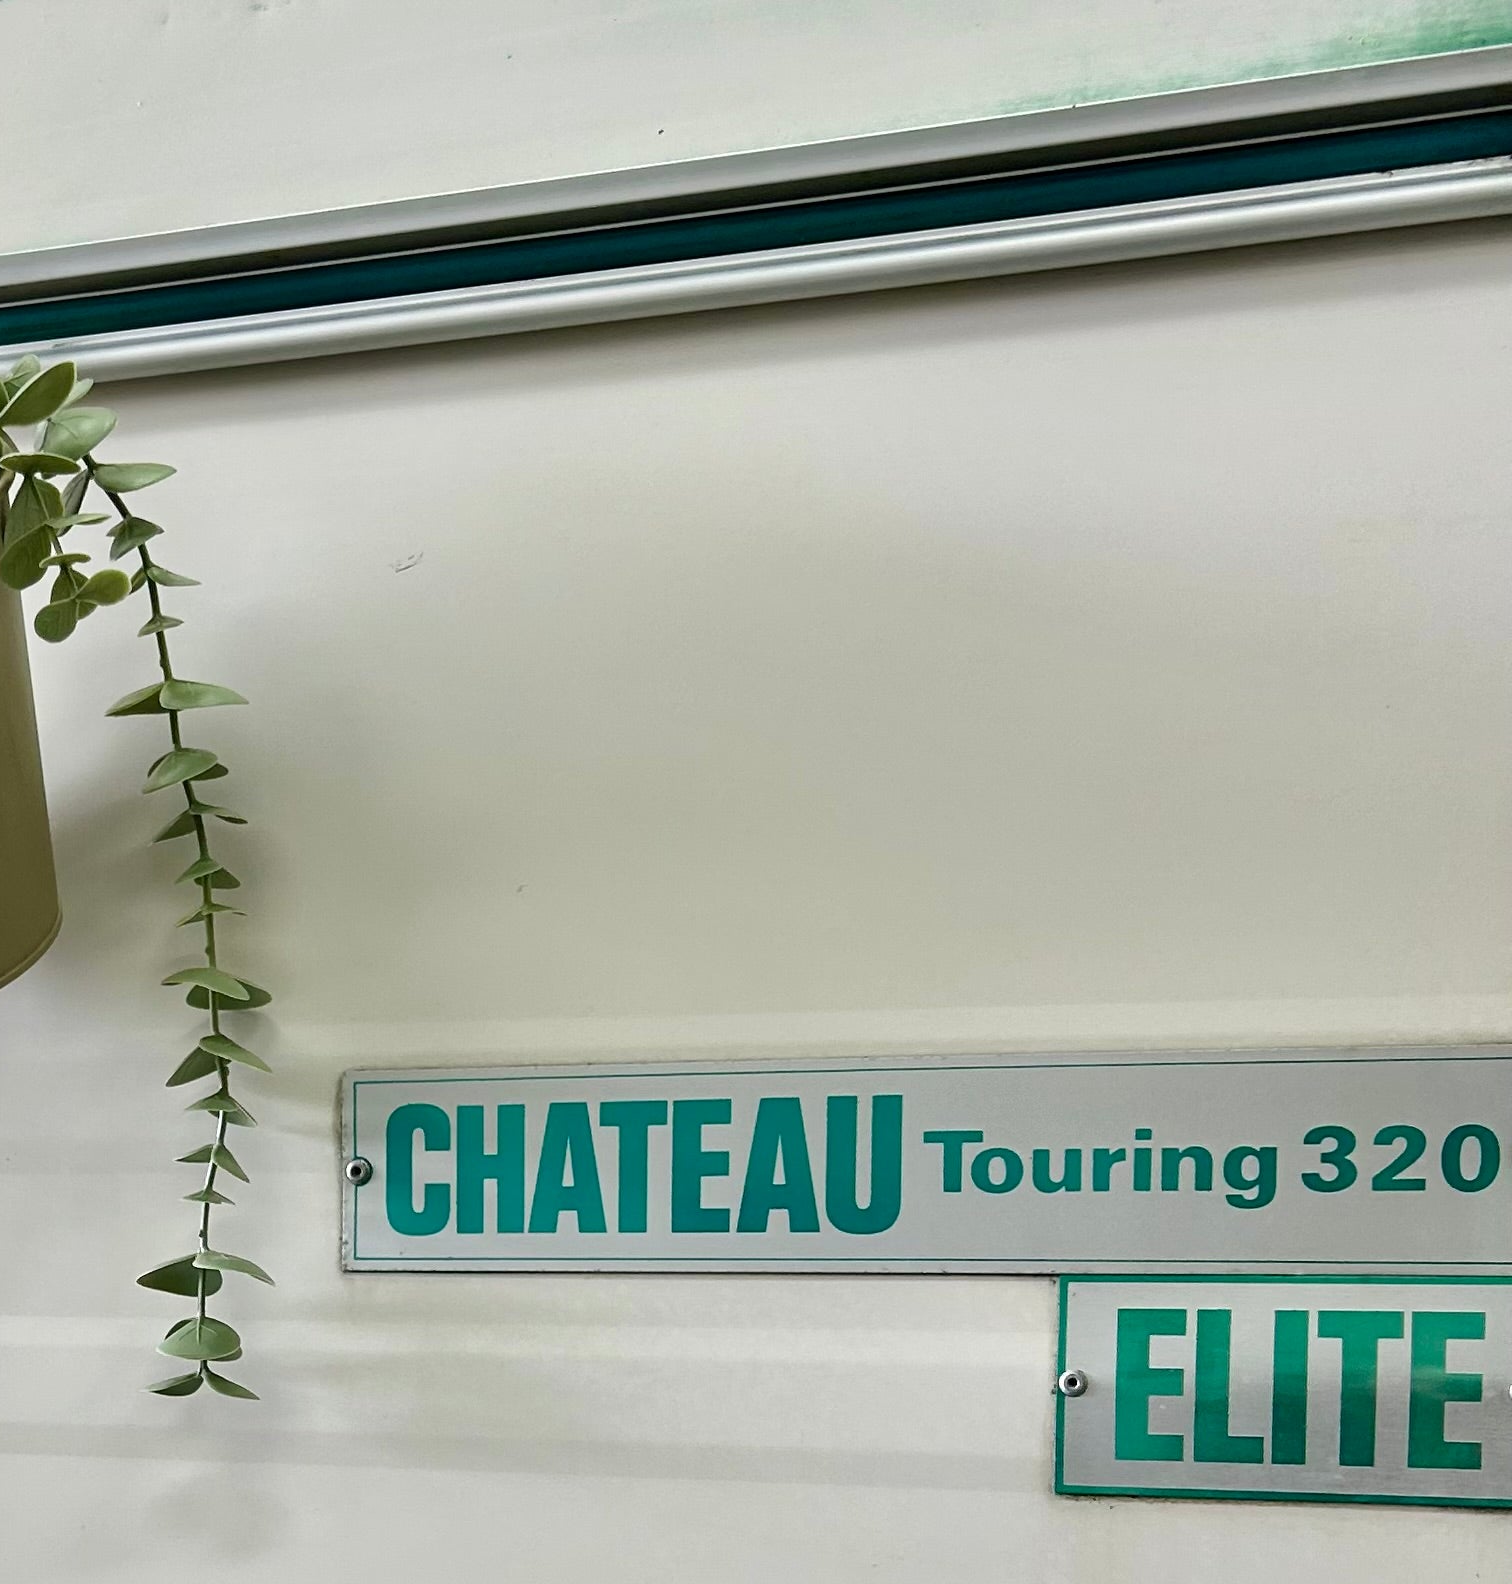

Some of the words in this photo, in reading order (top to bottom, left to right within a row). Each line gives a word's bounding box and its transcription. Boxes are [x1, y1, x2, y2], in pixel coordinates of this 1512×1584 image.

[385, 1094, 903, 1237] CHATEAU
[923, 1128, 1278, 1210] Touring
[1301, 1124, 1501, 1193] 320
[1114, 1308, 1486, 1470] ELITE
